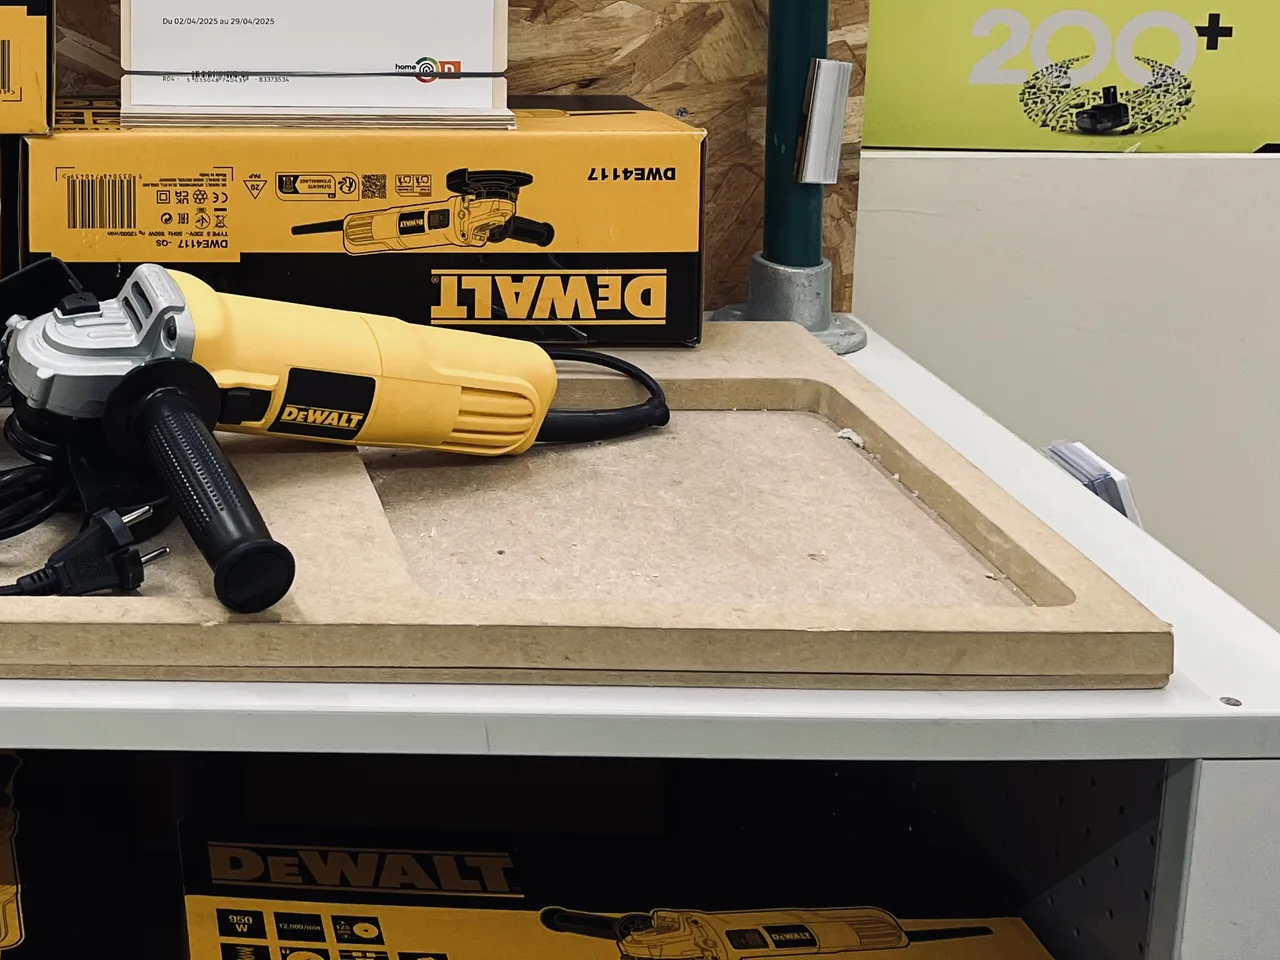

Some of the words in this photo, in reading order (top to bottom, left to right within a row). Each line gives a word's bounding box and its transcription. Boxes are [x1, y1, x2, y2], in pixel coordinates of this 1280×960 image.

[174, 17, 219, 25] 02/04/2025
[230, 17, 275, 25] 29/04/2025
[587, 167, 677, 181] DWE4117
[155, 239, 172, 247] -QS
[178, 239, 228, 248] DWE4117
[280, 406, 363, 428] DEWALT
[228, 915, 253, 925] 950
[236, 924, 248, 933] W
